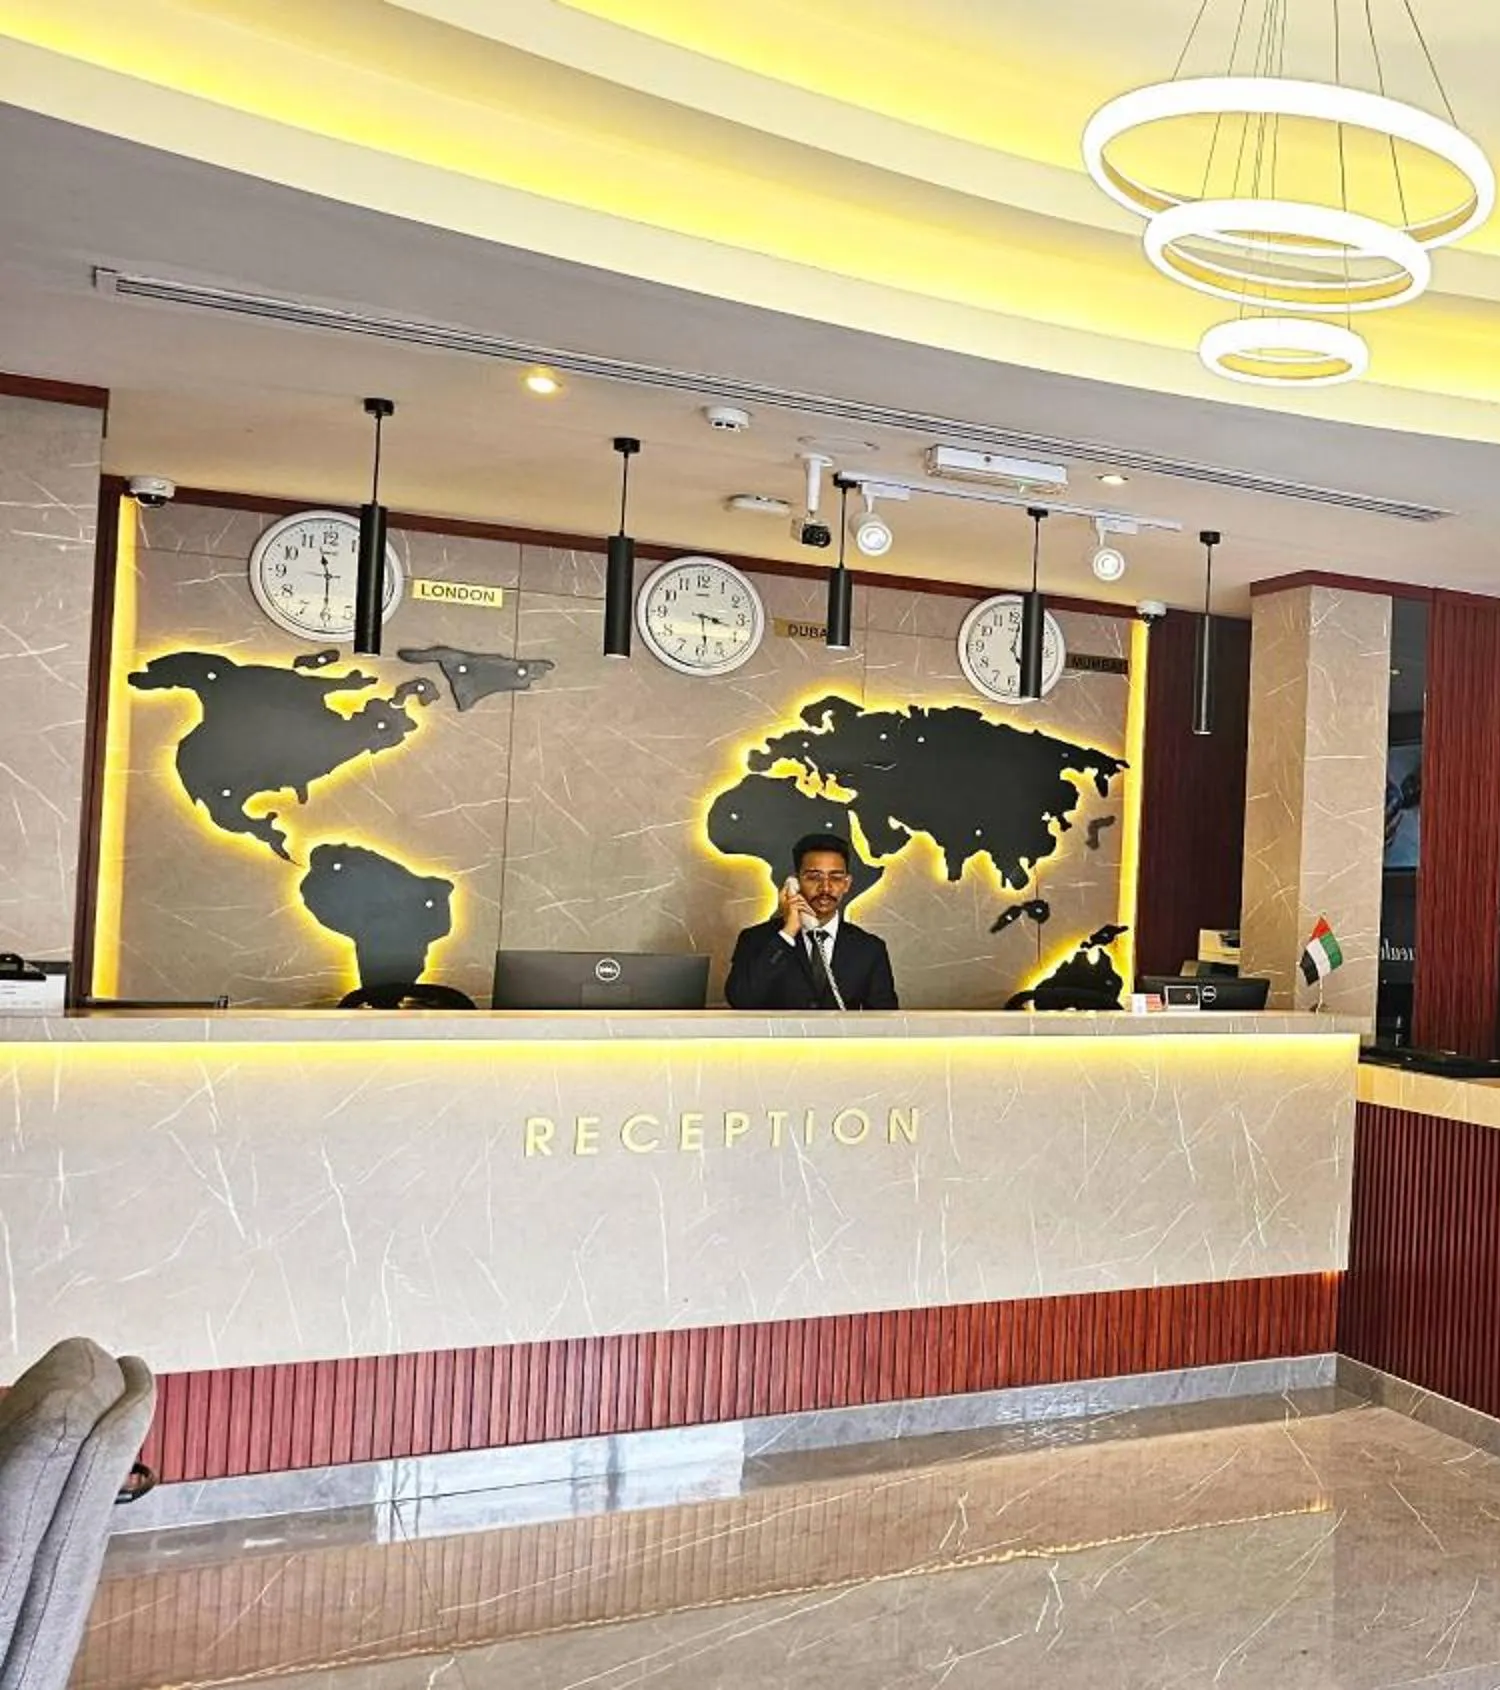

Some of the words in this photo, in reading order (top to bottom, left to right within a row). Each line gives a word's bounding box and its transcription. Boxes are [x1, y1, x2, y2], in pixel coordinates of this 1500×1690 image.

[301, 533, 314, 549] 11
[323, 531, 339, 547] 12
[285, 545, 299, 561] 10
[275, 563, 287, 578] 9
[679, 577, 689, 591] 11
[697, 575, 710, 589] 12
[281, 583, 293, 598] 8
[421, 583, 496, 603] LONDON
[731, 594, 740, 609] 2
[657, 604, 667, 618] 9
[736, 613, 745, 627] 3
[787, 624, 828, 639] DUBA
[991, 669, 1000, 682] 7
[524, 1107, 922, 1158] RECEPTION
